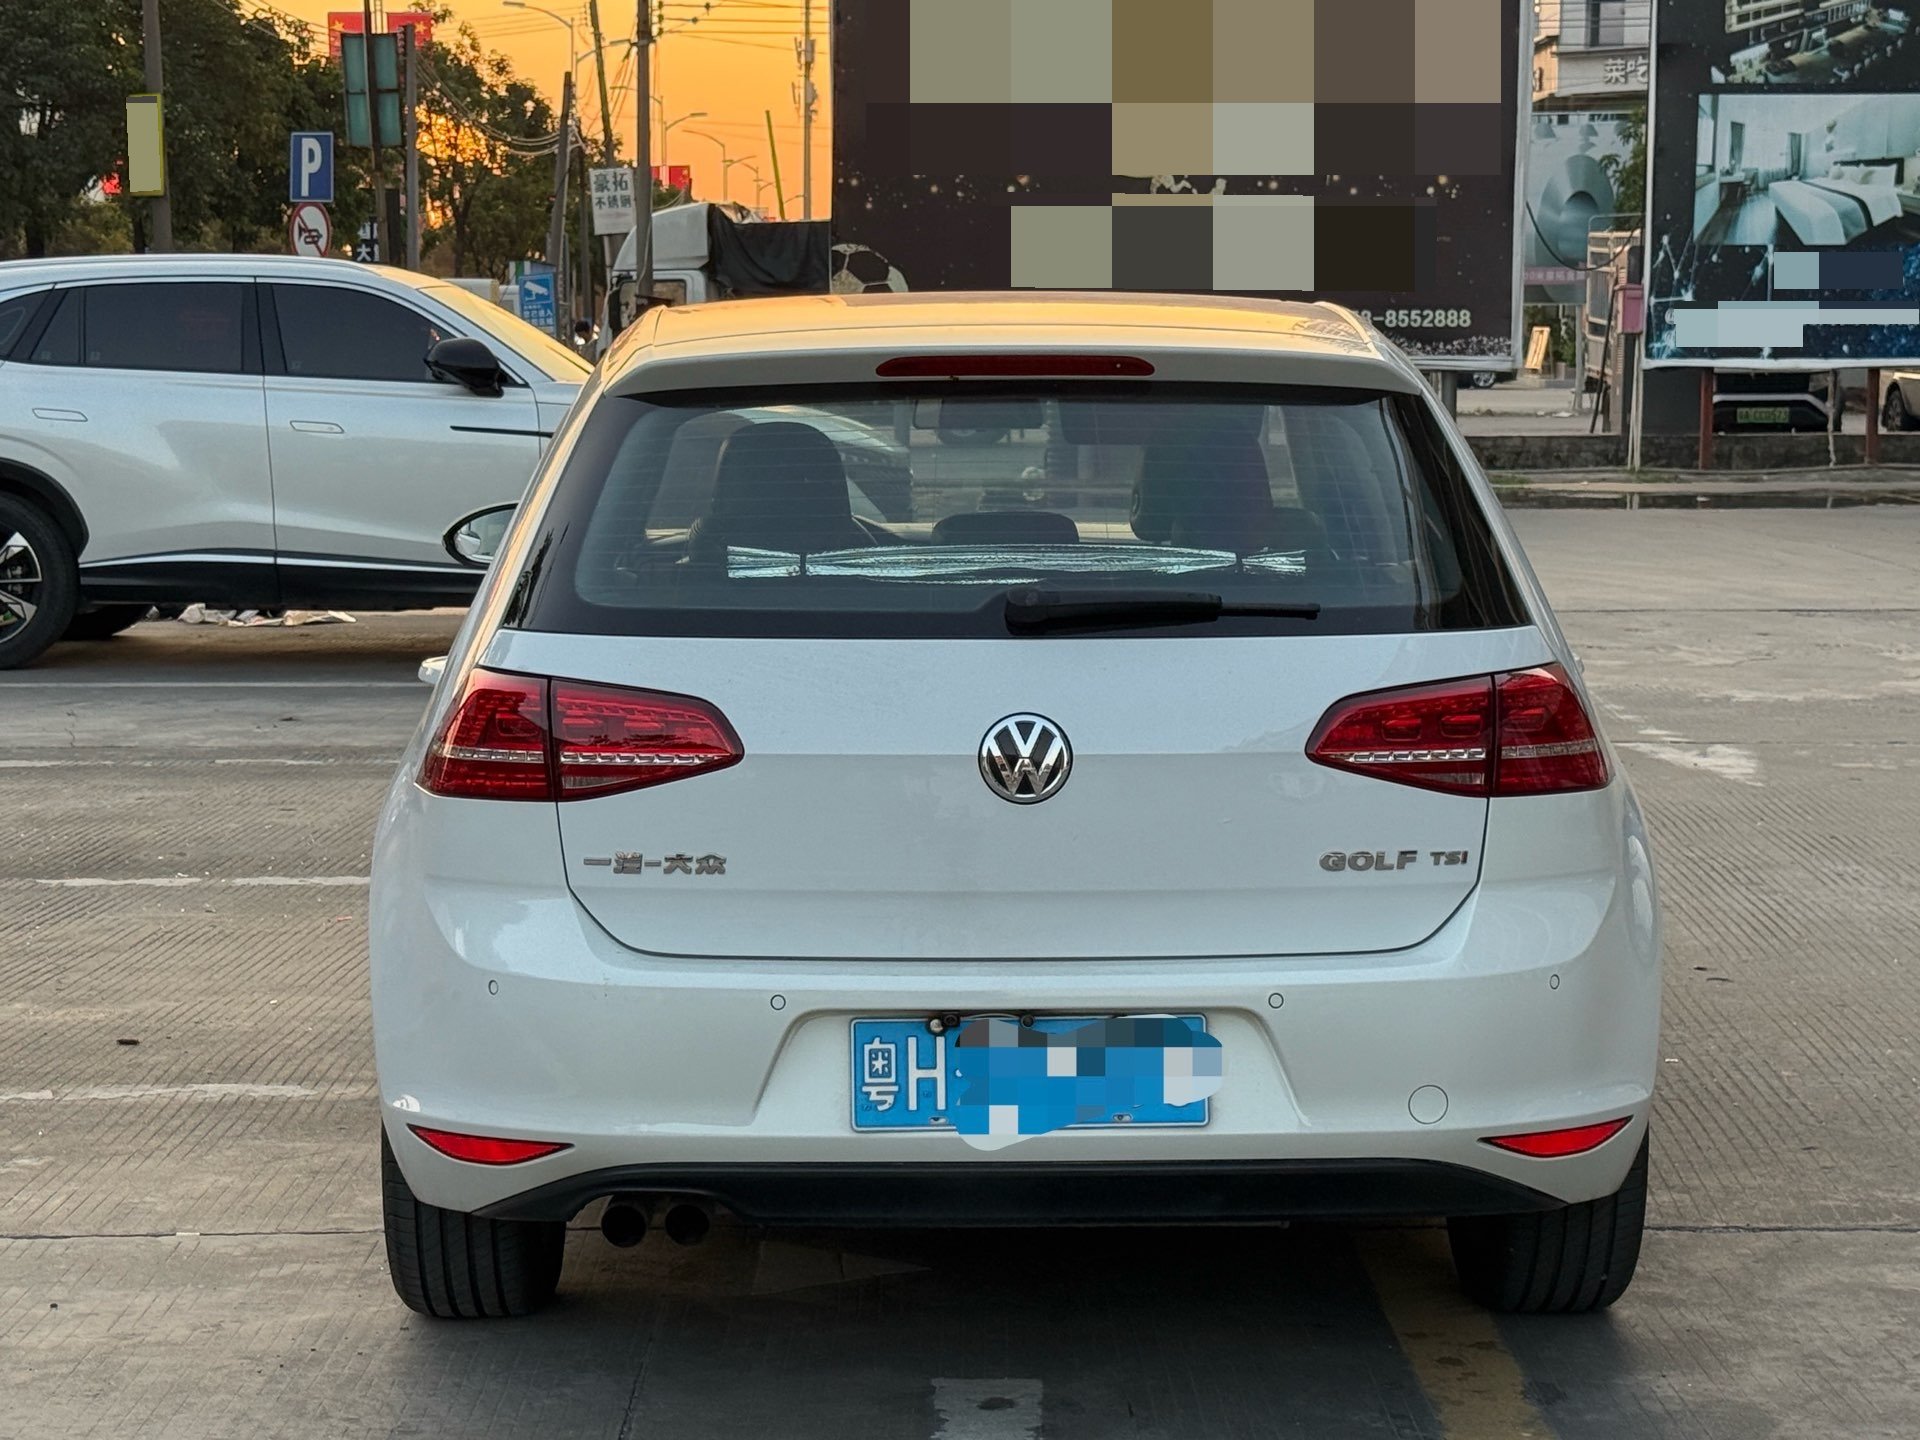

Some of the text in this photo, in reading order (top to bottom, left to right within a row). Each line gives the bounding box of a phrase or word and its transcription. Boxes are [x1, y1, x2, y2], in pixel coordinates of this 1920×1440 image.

[300, 137, 322, 197] P
[1319, 850, 1469, 872] GOLF TSI
